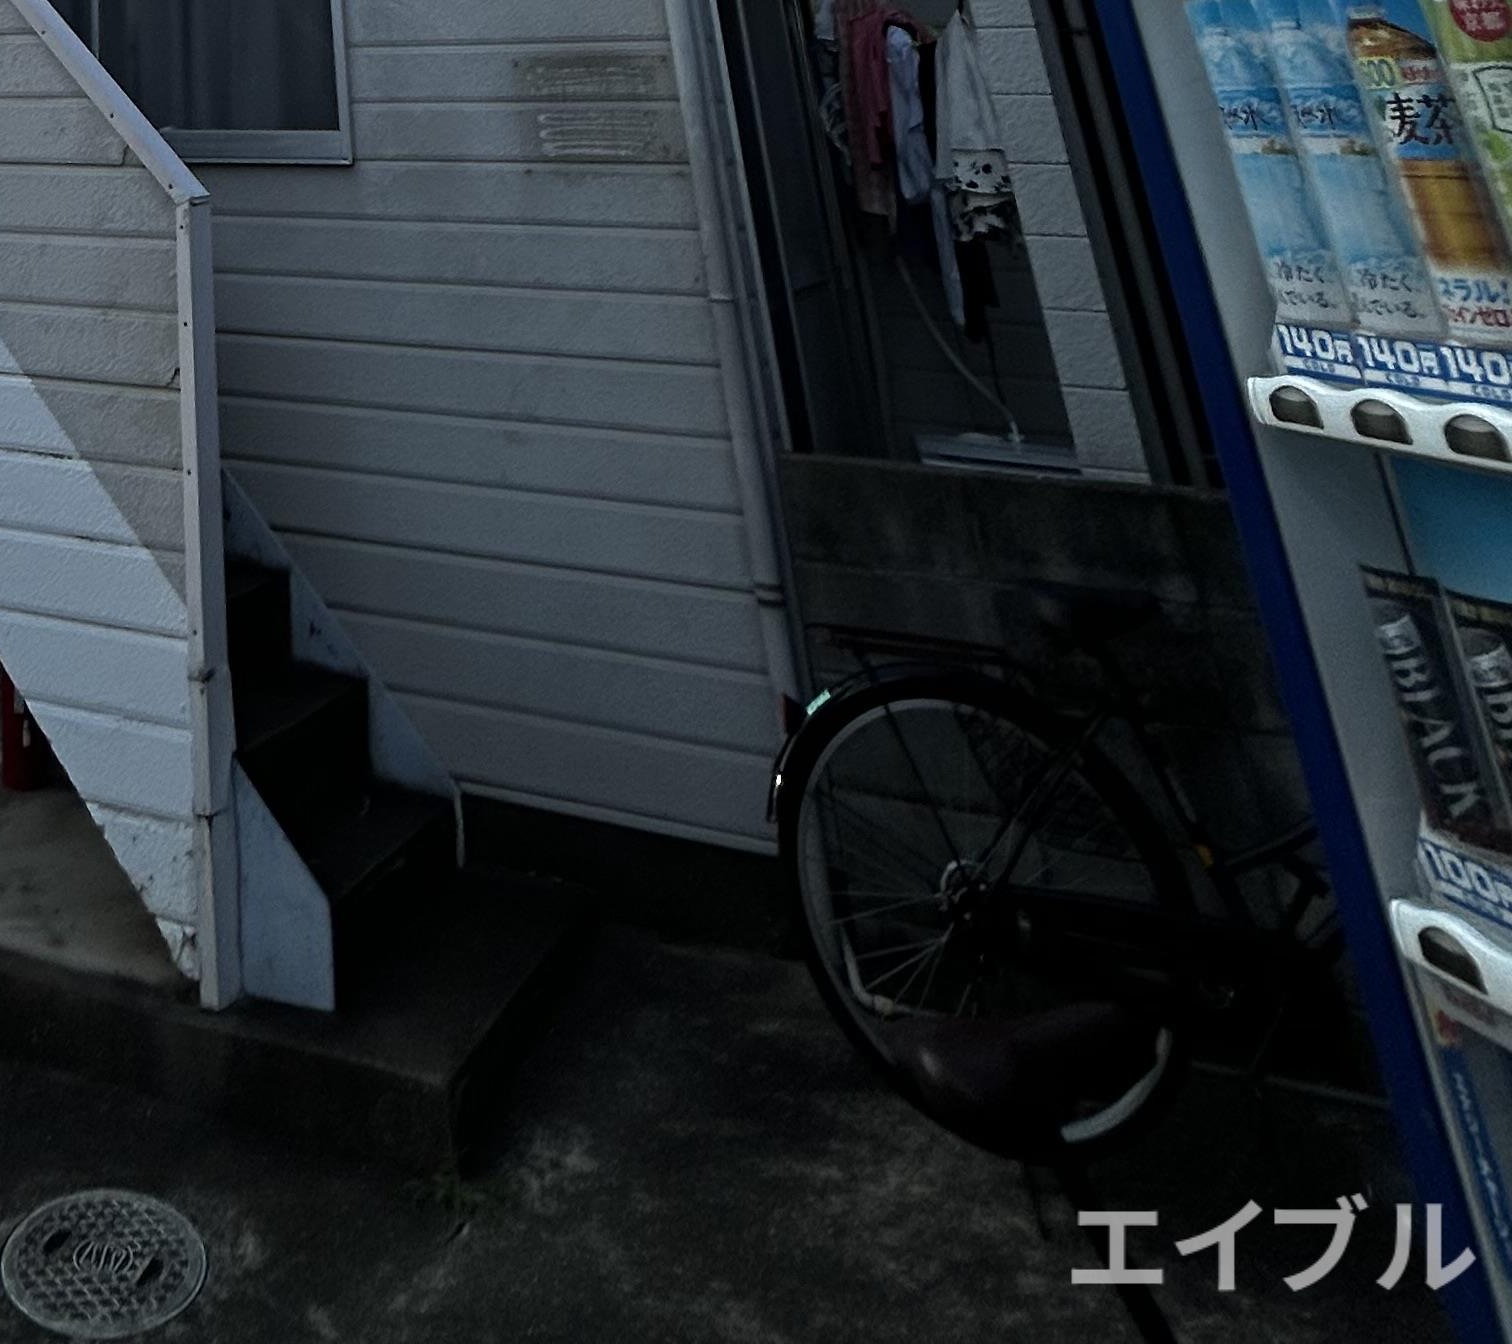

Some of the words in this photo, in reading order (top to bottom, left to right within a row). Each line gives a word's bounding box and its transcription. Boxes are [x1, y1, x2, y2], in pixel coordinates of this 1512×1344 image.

[1387, 92, 1456, 145] 麦茶
[1440, 345, 1512, 387] 140
[1386, 657, 1480, 819] BLACK
